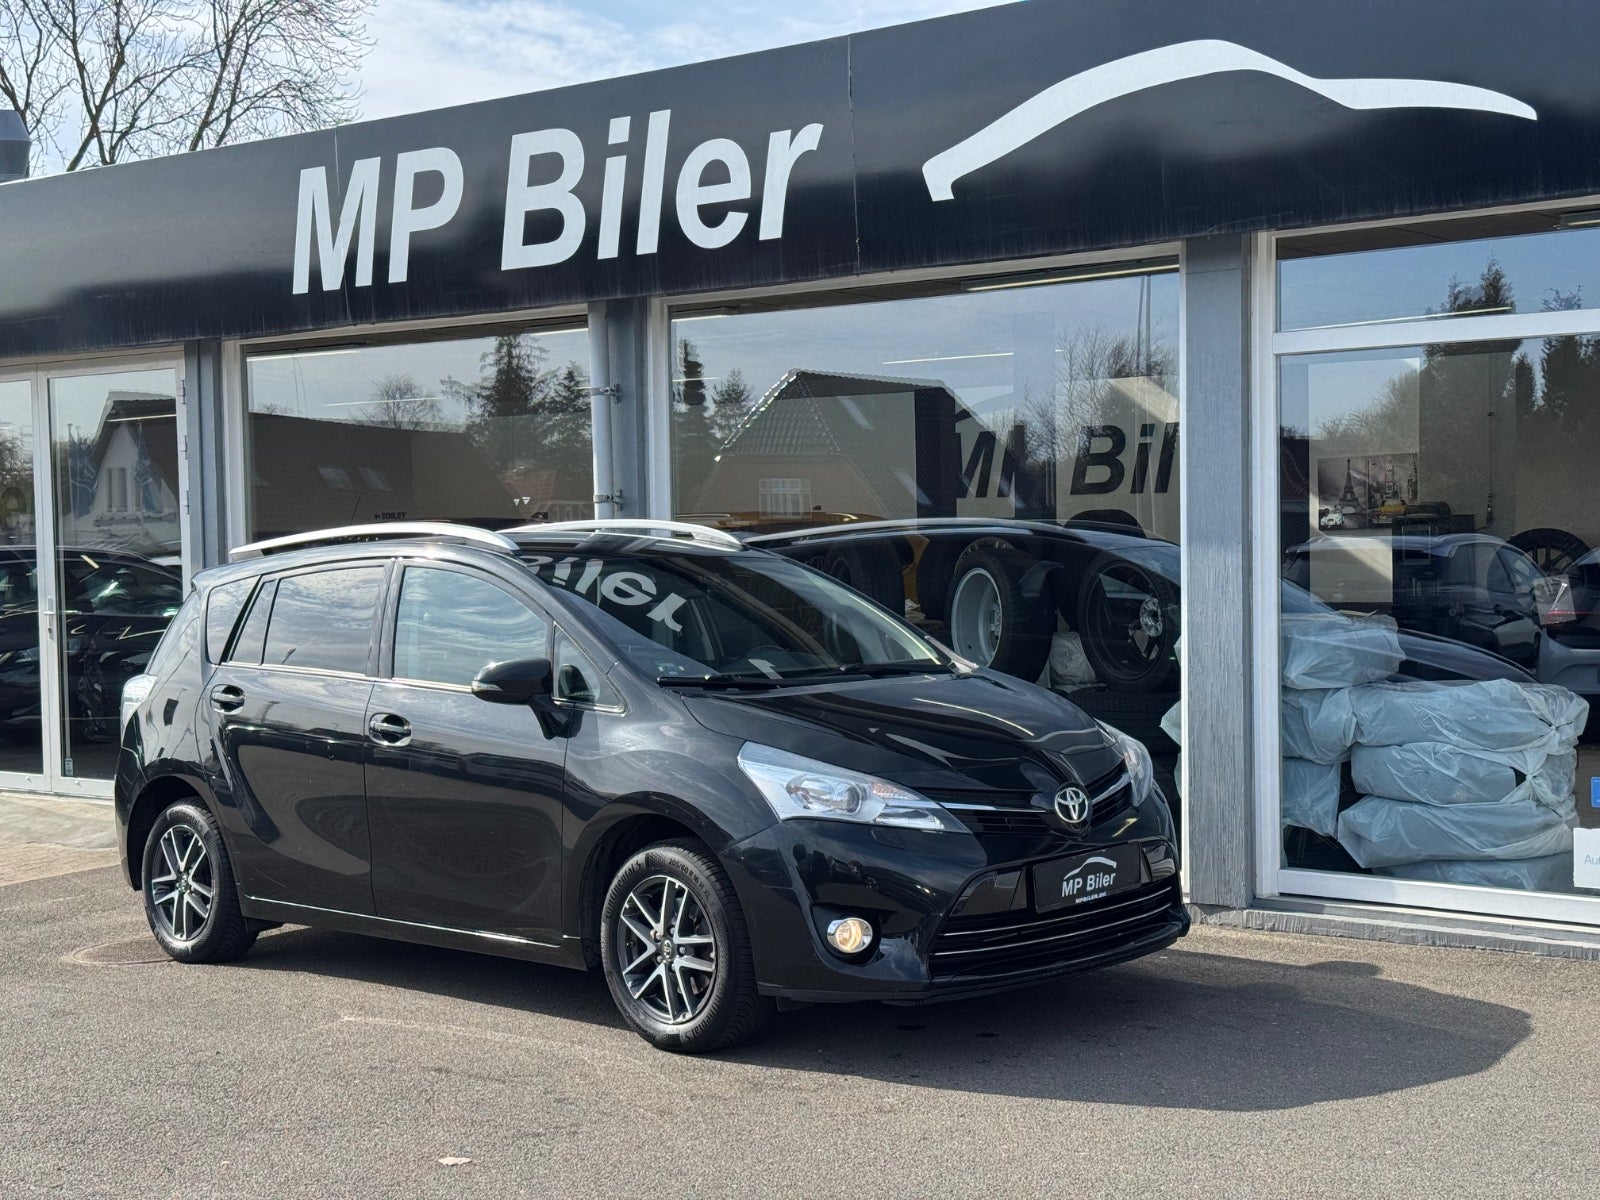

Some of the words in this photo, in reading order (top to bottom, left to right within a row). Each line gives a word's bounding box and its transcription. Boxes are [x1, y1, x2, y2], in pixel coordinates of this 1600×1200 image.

[292, 146, 464, 296] MP
[501, 108, 824, 271] Biler
[1062, 878, 1083, 897] MP
[1087, 872, 1116, 891] Biler
